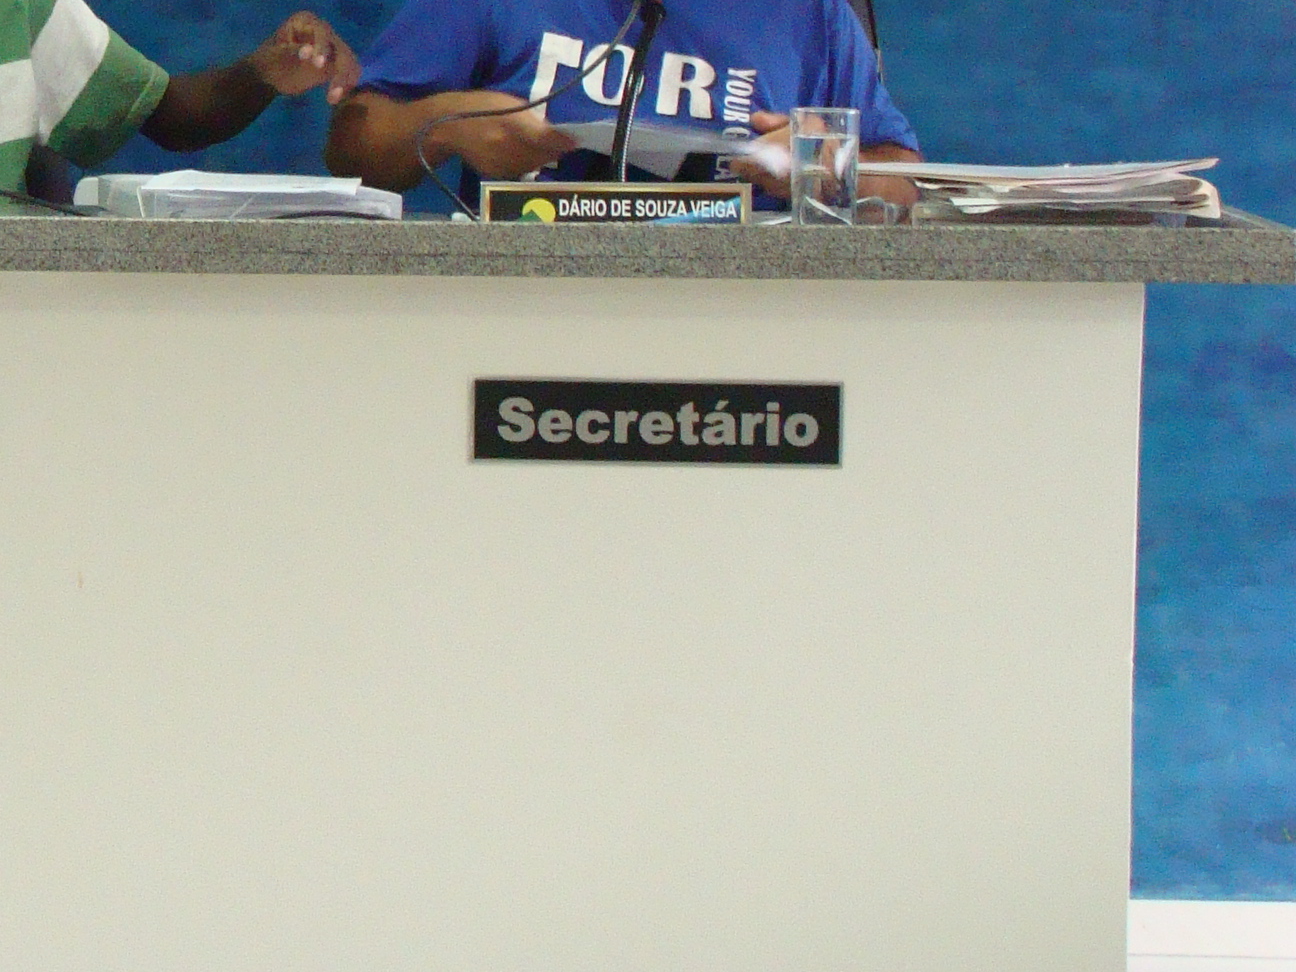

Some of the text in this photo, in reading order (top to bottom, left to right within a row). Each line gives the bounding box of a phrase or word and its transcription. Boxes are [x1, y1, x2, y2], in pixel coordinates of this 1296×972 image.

[723, 67, 757, 123] YOUR
[558, 193, 737, 218] DÁRIO DE SOUZA VEIGA
[497, 395, 820, 448] Secretário
